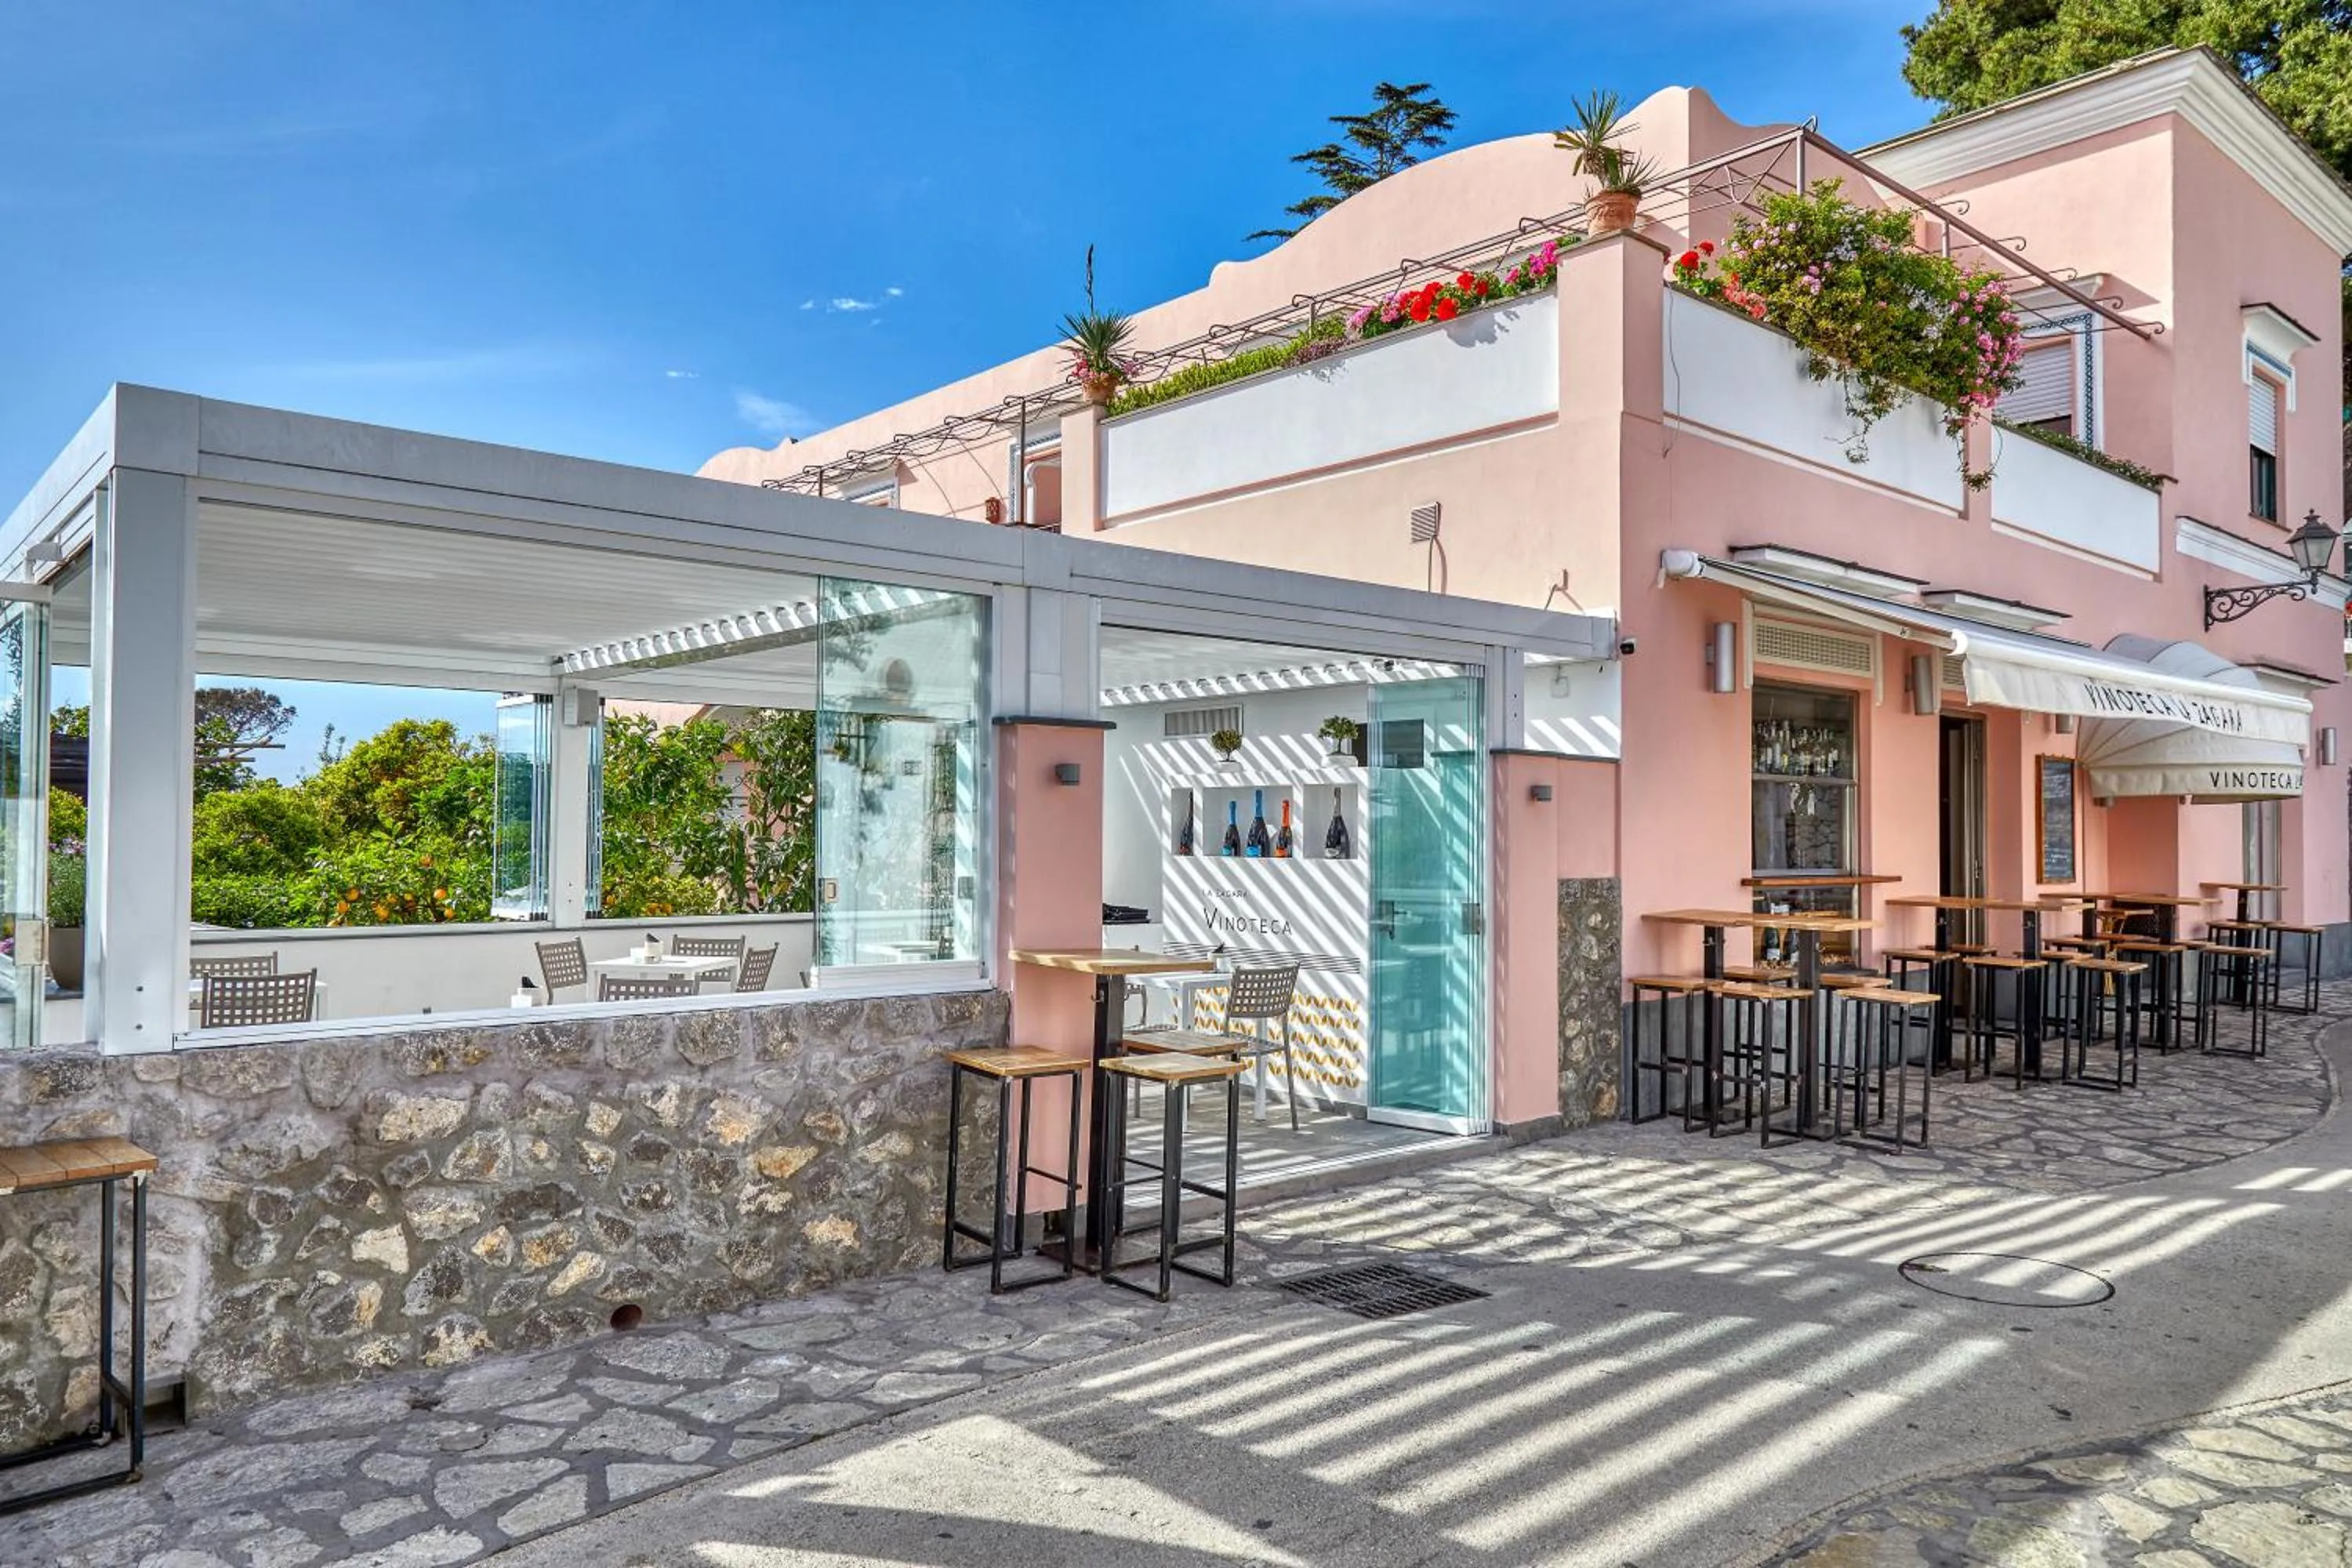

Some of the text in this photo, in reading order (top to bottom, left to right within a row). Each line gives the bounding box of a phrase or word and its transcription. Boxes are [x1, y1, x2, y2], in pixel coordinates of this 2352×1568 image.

[2083, 683, 2176, 717] VINOTECA
[2191, 701, 2243, 732] ZAGARA
[2209, 771, 2292, 789] VINOTECA
[1216, 888, 1247, 898] ZAGARA
[1203, 907, 1292, 935] VINOTECA
